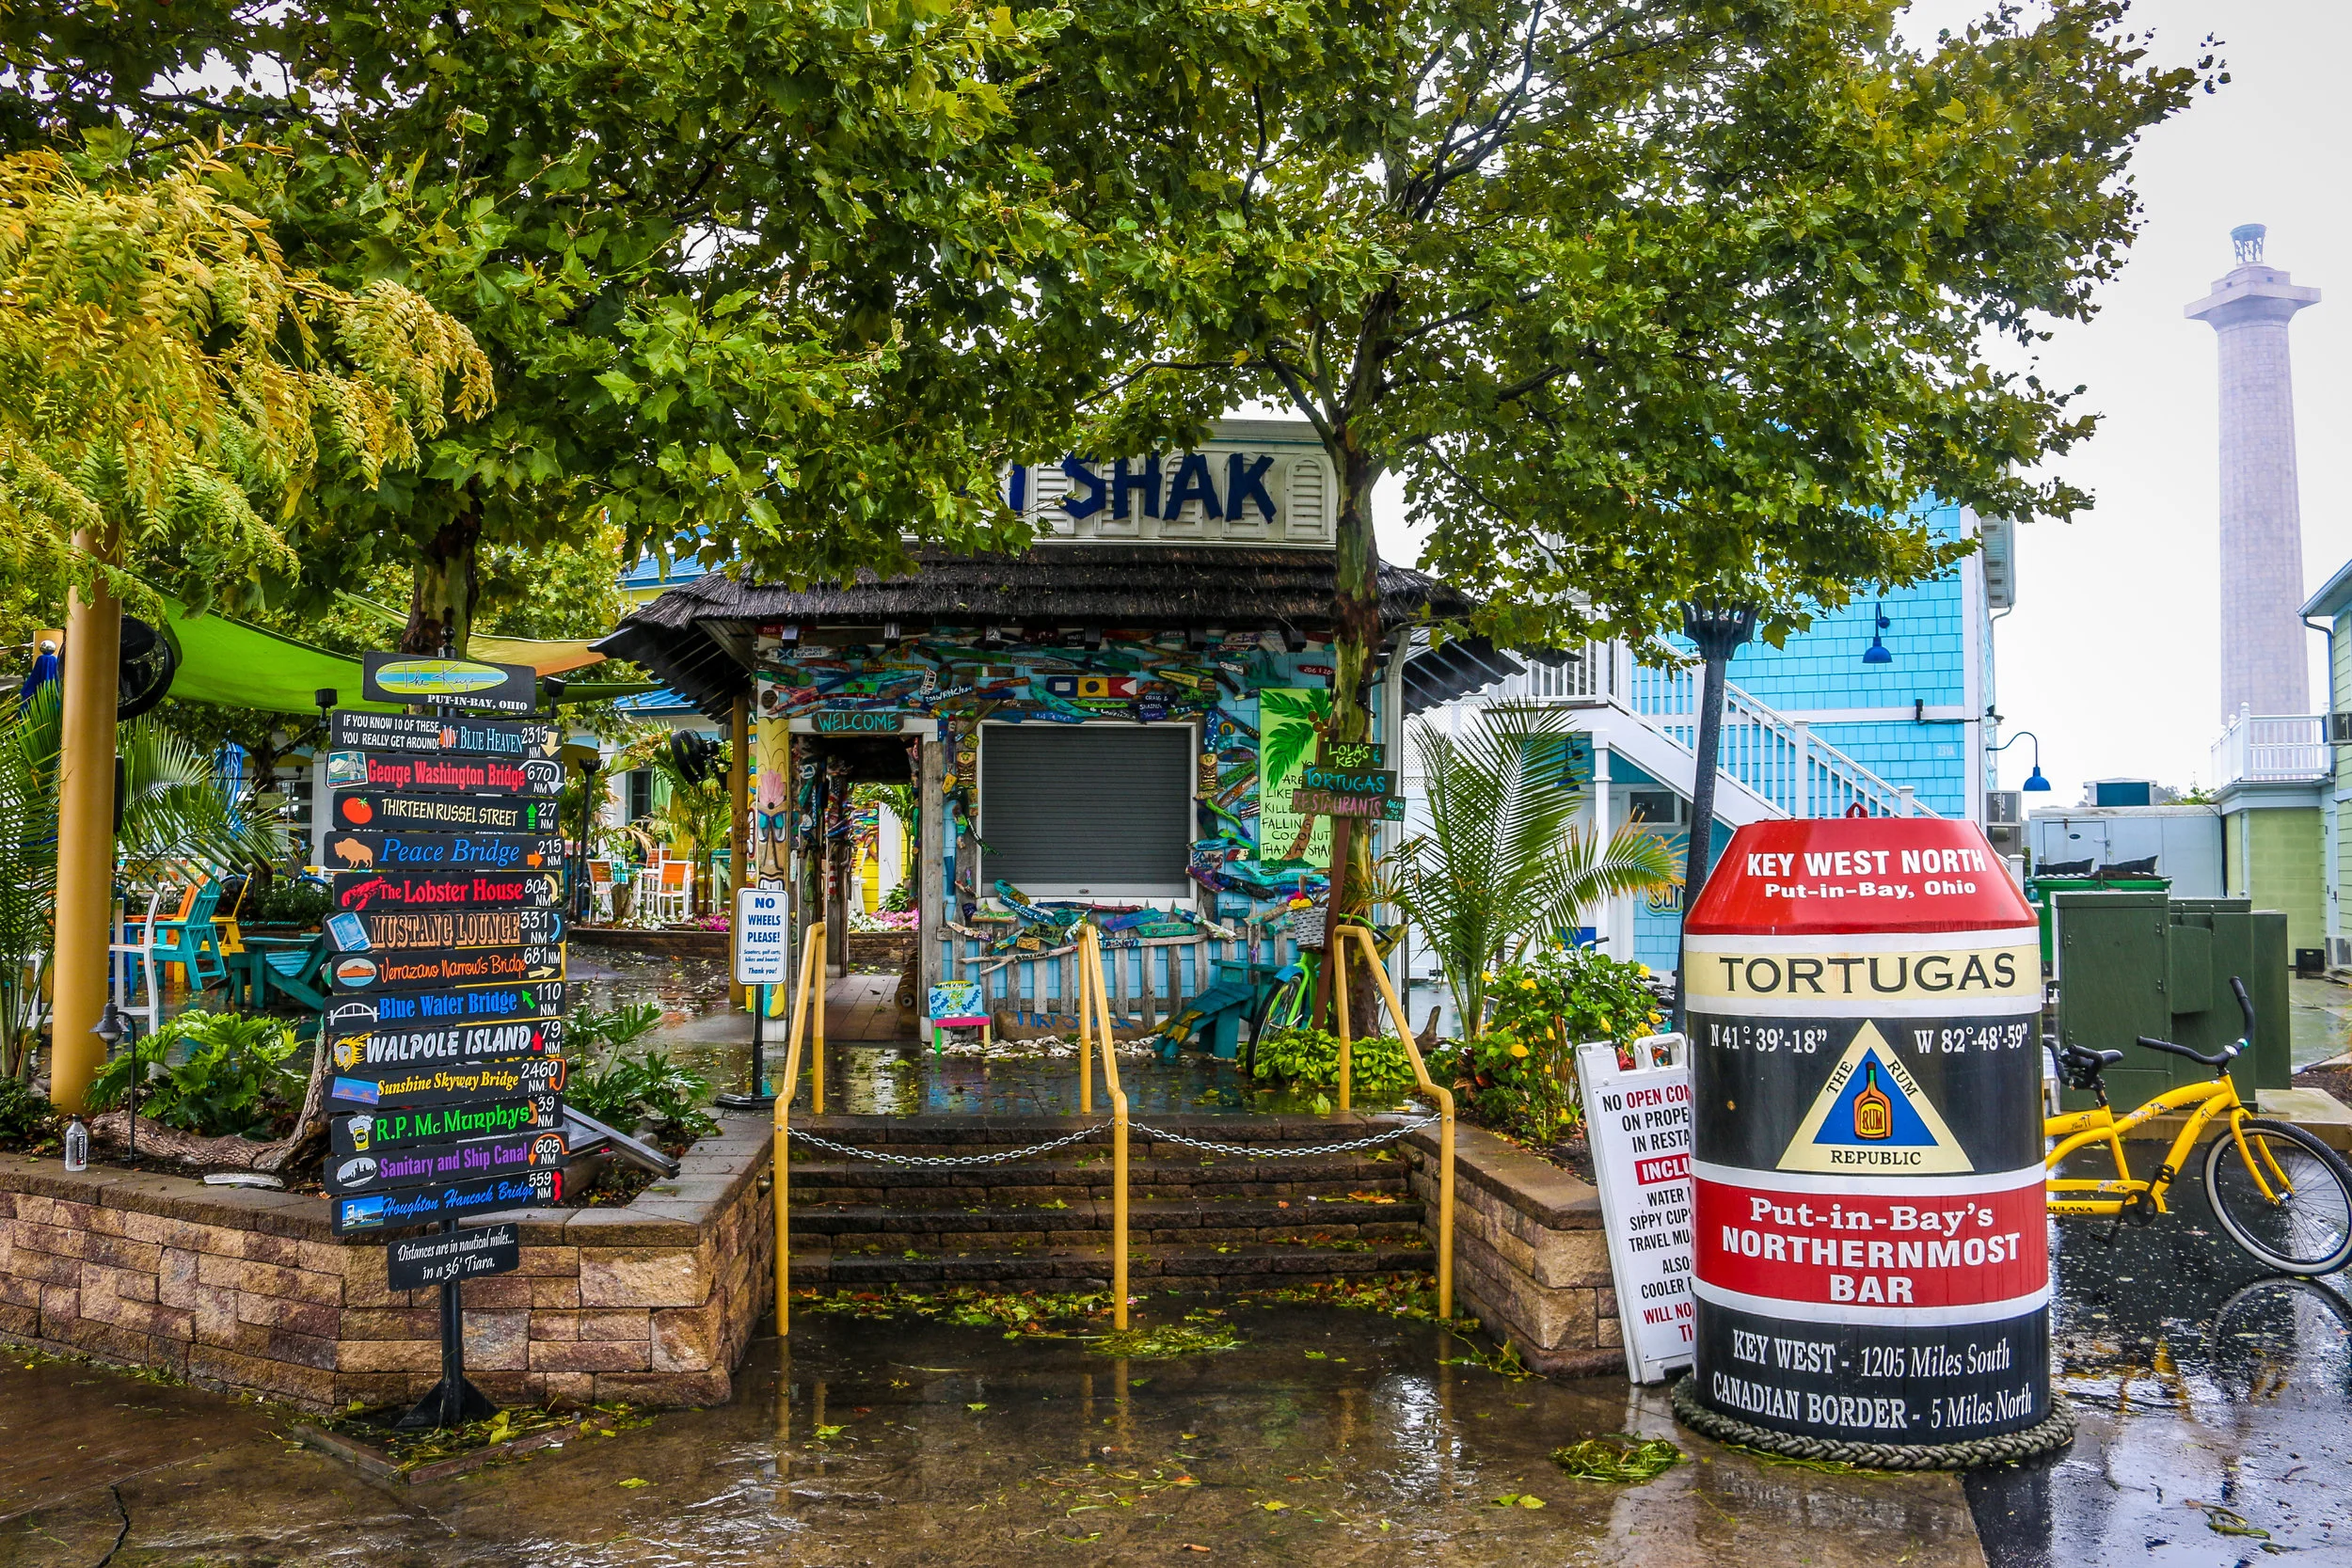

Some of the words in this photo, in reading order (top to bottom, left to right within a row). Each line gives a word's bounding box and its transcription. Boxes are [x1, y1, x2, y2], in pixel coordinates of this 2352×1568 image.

[1060, 451, 1277, 524] SHAK
[383, 659, 432, 689] The
[433, 659, 485, 693] Keys
[427, 694, 496, 709] PUT-IN-BAY,
[499, 700, 528, 711] OHIO
[342, 715, 352, 727] IF
[353, 715, 368, 728] YOU
[370, 717, 392, 730] KNOW
[394, 718, 402, 730] 10
[405, 719, 414, 732] OF
[416, 720, 441, 734] THESE,
[818, 712, 898, 733] WELCOME
[342, 732, 358, 744] YOU
[362, 734, 389, 747] REALLY
[390, 736, 405, 748] GET
[406, 736, 440, 751] AROUND!
[521, 725, 548, 745] 2315
[529, 747, 540, 758] NM
[1328, 743, 1370, 758] LOLA'S
[1335, 755, 1361, 768] KEY
[368, 758, 411, 788] George
[414, 761, 485, 791] Washington
[487, 764, 526, 792] Bridge
[527, 765, 551, 782] 670
[1303, 767, 1386, 793] TORTUGAS
[533, 783, 548, 794] NM
[382, 798, 434, 820] THIRTEEN
[436, 803, 477, 823] RUSSEL
[479, 807, 518, 827] STREET
[538, 802, 557, 816] 27
[1293, 792, 1382, 818] RESTAURANTS
[540, 819, 553, 830] NM
[1261, 817, 1311, 831] FALLING
[379, 838, 444, 863] Peace
[451, 839, 520, 867] Bridge
[538, 839, 562, 855] 215
[547, 855, 561, 867] NM
[1261, 844, 1292, 857] THAN
[1295, 844, 1305, 854] A
[1746, 852, 1794, 877] KEY
[1804, 849, 1890, 877] WEST
[1901, 848, 1987, 874] NORTH
[379, 884, 402, 899] The
[404, 879, 469, 904] Lobster
[472, 879, 524, 901] House
[524, 879, 548, 895] 804
[1765, 882, 1915, 899] Put-in-Bay,
[1924, 879, 1977, 895] Ohio
[535, 894, 551, 907] NM
[755, 897, 775, 909] NO
[371, 913, 453, 949] MUSTANG
[455, 912, 520, 945] LOUNGE
[520, 911, 548, 929] 331
[748, 914, 781, 926] WHEELS
[531, 932, 548, 944] NM
[747, 931, 781, 943] PLEASE!
[379, 957, 439, 983] Verrazano
[441, 956, 488, 979] Narrow's
[489, 953, 527, 979] Bridge
[524, 946, 548, 965] 681
[548, 951, 561, 964] NM
[1719, 952, 2015, 994] TORTUGAS
[536, 983, 562, 1001] 110
[379, 998, 416, 1020] Blue
[420, 994, 464, 1016] Water
[468, 990, 517, 1014] Bridge
[540, 1004, 557, 1017] NM
[541, 1021, 562, 1038] 79
[1710, 1023, 1720, 1047] N
[1914, 1030, 1933, 1053] W
[367, 1031, 459, 1064] WALPOLE
[465, 1025, 532, 1054] ISLAND
[545, 1041, 561, 1054] NM
[378, 1075, 431, 1096] Sunshine
[434, 1071, 479, 1092] Skyway
[481, 1070, 518, 1091] Bridge
[521, 1060, 558, 1080] 2460
[1826, 1061, 1853, 1094] THE
[1886, 1059, 1918, 1098] RUM
[537, 1096, 555, 1113] 39
[1602, 1094, 1622, 1112] NO
[1626, 1087, 1662, 1108] OPEN
[537, 1114, 553, 1128] NM
[1622, 1114, 1642, 1132] ON
[1862, 1108, 1883, 1131] RUM
[535, 1139, 560, 1154] 605
[1632, 1135, 1647, 1153] IN
[380, 1155, 434, 1179] Sanitary
[437, 1149, 460, 1172] and
[464, 1147, 490, 1171] Ship
[495, 1142, 528, 1165] Canal
[540, 1153, 556, 1164] NM
[1831, 1149, 1921, 1165] REPUBLIC
[529, 1171, 551, 1187] 559
[383, 1194, 439, 1219] Houghton
[444, 1184, 494, 1209] Hancock
[498, 1180, 534, 1202] Bridge
[537, 1187, 551, 1199] NM
[1646, 1188, 1685, 1207] WATER
[1629, 1212, 1662, 1231] SIPPY
[1750, 1196, 1994, 1237] Put-in-Bay's
[397, 1243, 435, 1261] Distances
[436, 1245, 449, 1257] are
[450, 1239, 458, 1254] in
[459, 1227, 491, 1252] nautical
[1629, 1232, 1671, 1253] TRAVEL
[1722, 1226, 2021, 1269] NORTHERNMOST
[422, 1266, 433, 1280] in
[437, 1266, 443, 1278] a
[443, 1257, 463, 1280] 36'
[464, 1255, 496, 1273] Tiara.
[1641, 1278, 1685, 1299] COOLER
[1830, 1274, 1914, 1304] BAR
[1643, 1306, 1673, 1325] WILL
[1732, 1328, 1770, 1365] KEY
[1773, 1337, 1836, 1374] WEST
[1860, 1346, 1905, 1378] 1205
[1909, 1344, 1963, 1378] Miles
[1967, 1337, 2010, 1375] South
[1713, 1370, 1800, 1420] CANADIAN
[1807, 1392, 1907, 1429] BORDER
[1931, 1397, 1941, 1429] 5
[1945, 1392, 1993, 1428] Miles
[1995, 1382, 2032, 1423] North
